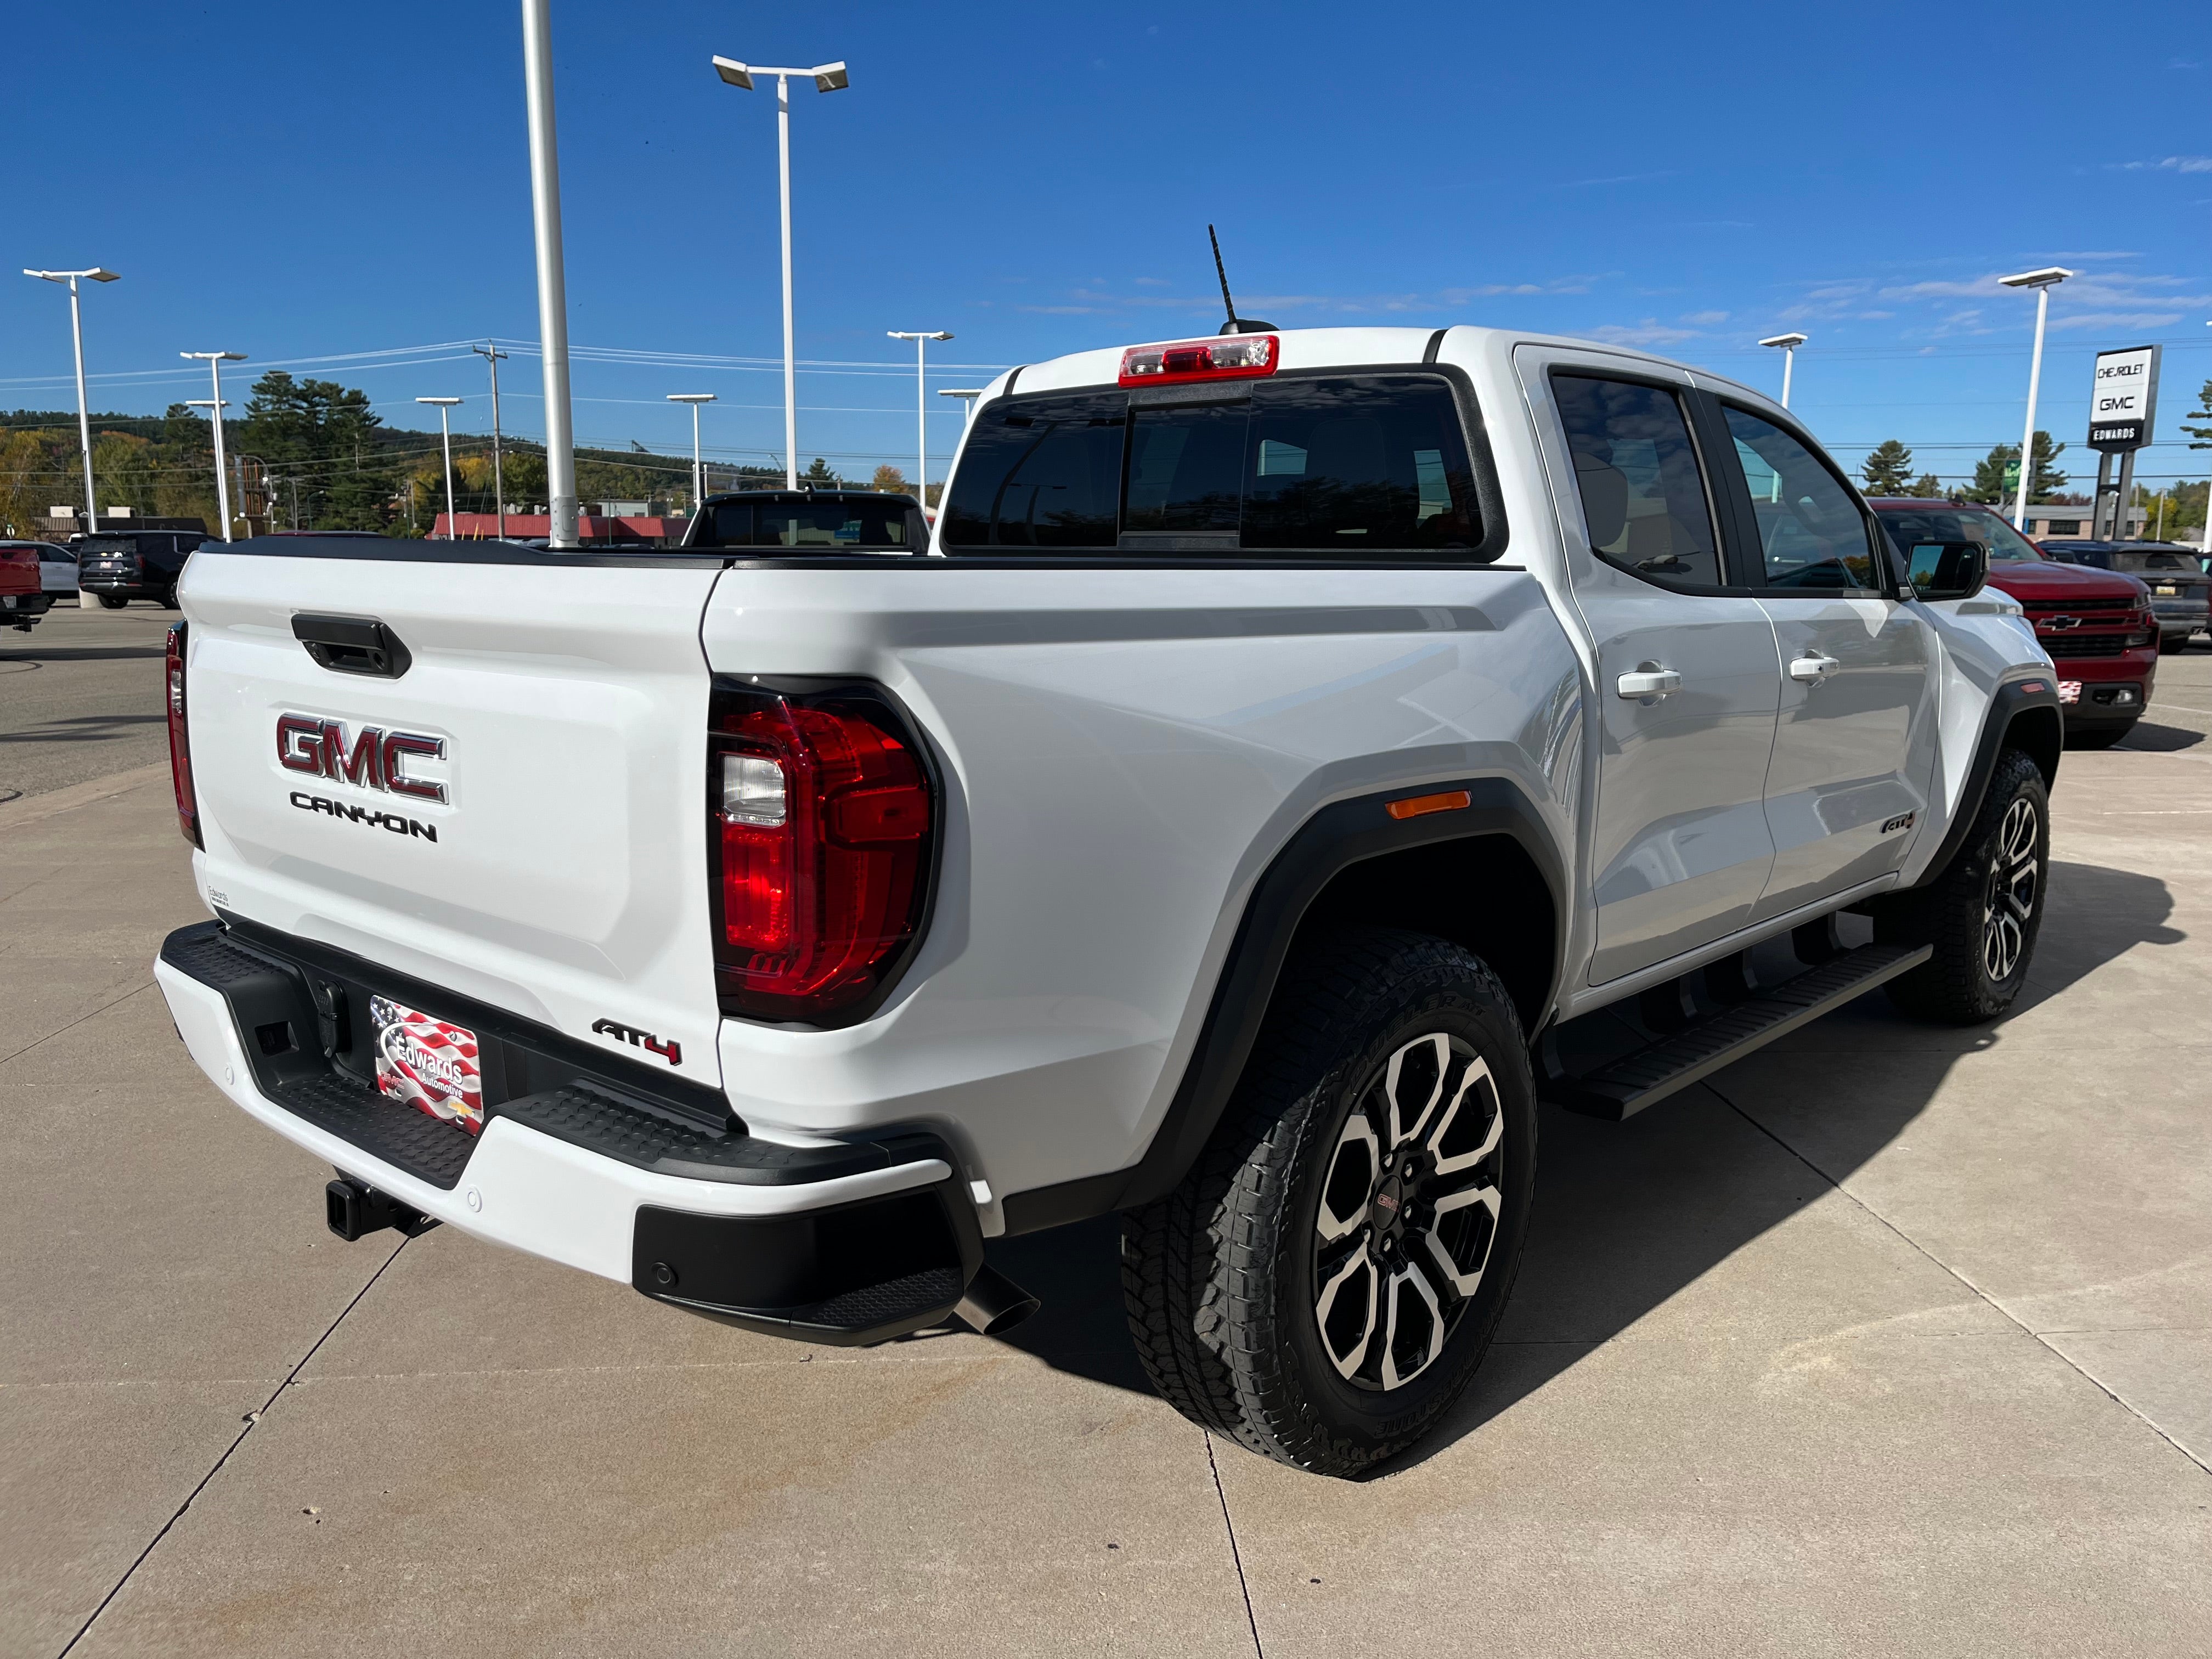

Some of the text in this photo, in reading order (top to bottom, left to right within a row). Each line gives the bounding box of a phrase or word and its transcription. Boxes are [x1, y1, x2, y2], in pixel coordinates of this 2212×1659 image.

[2097, 364, 2144, 379] CHEVROLET
[2100, 396, 2135, 411] GMC
[2093, 427, 2135, 441] EDWARDS
[276, 712, 449, 805] GMC
[290, 791, 438, 843] CANYON
[1880, 811, 1915, 833] AT4
[591, 1018, 682, 1066] AT4
[1351, 991, 1458, 1094] DUELER
[396, 1035, 463, 1085] Edwards
[380, 1071, 404, 1089] GMC
[422, 1072, 464, 1098] Automotive
[1377, 1193, 1401, 1214] GMC
